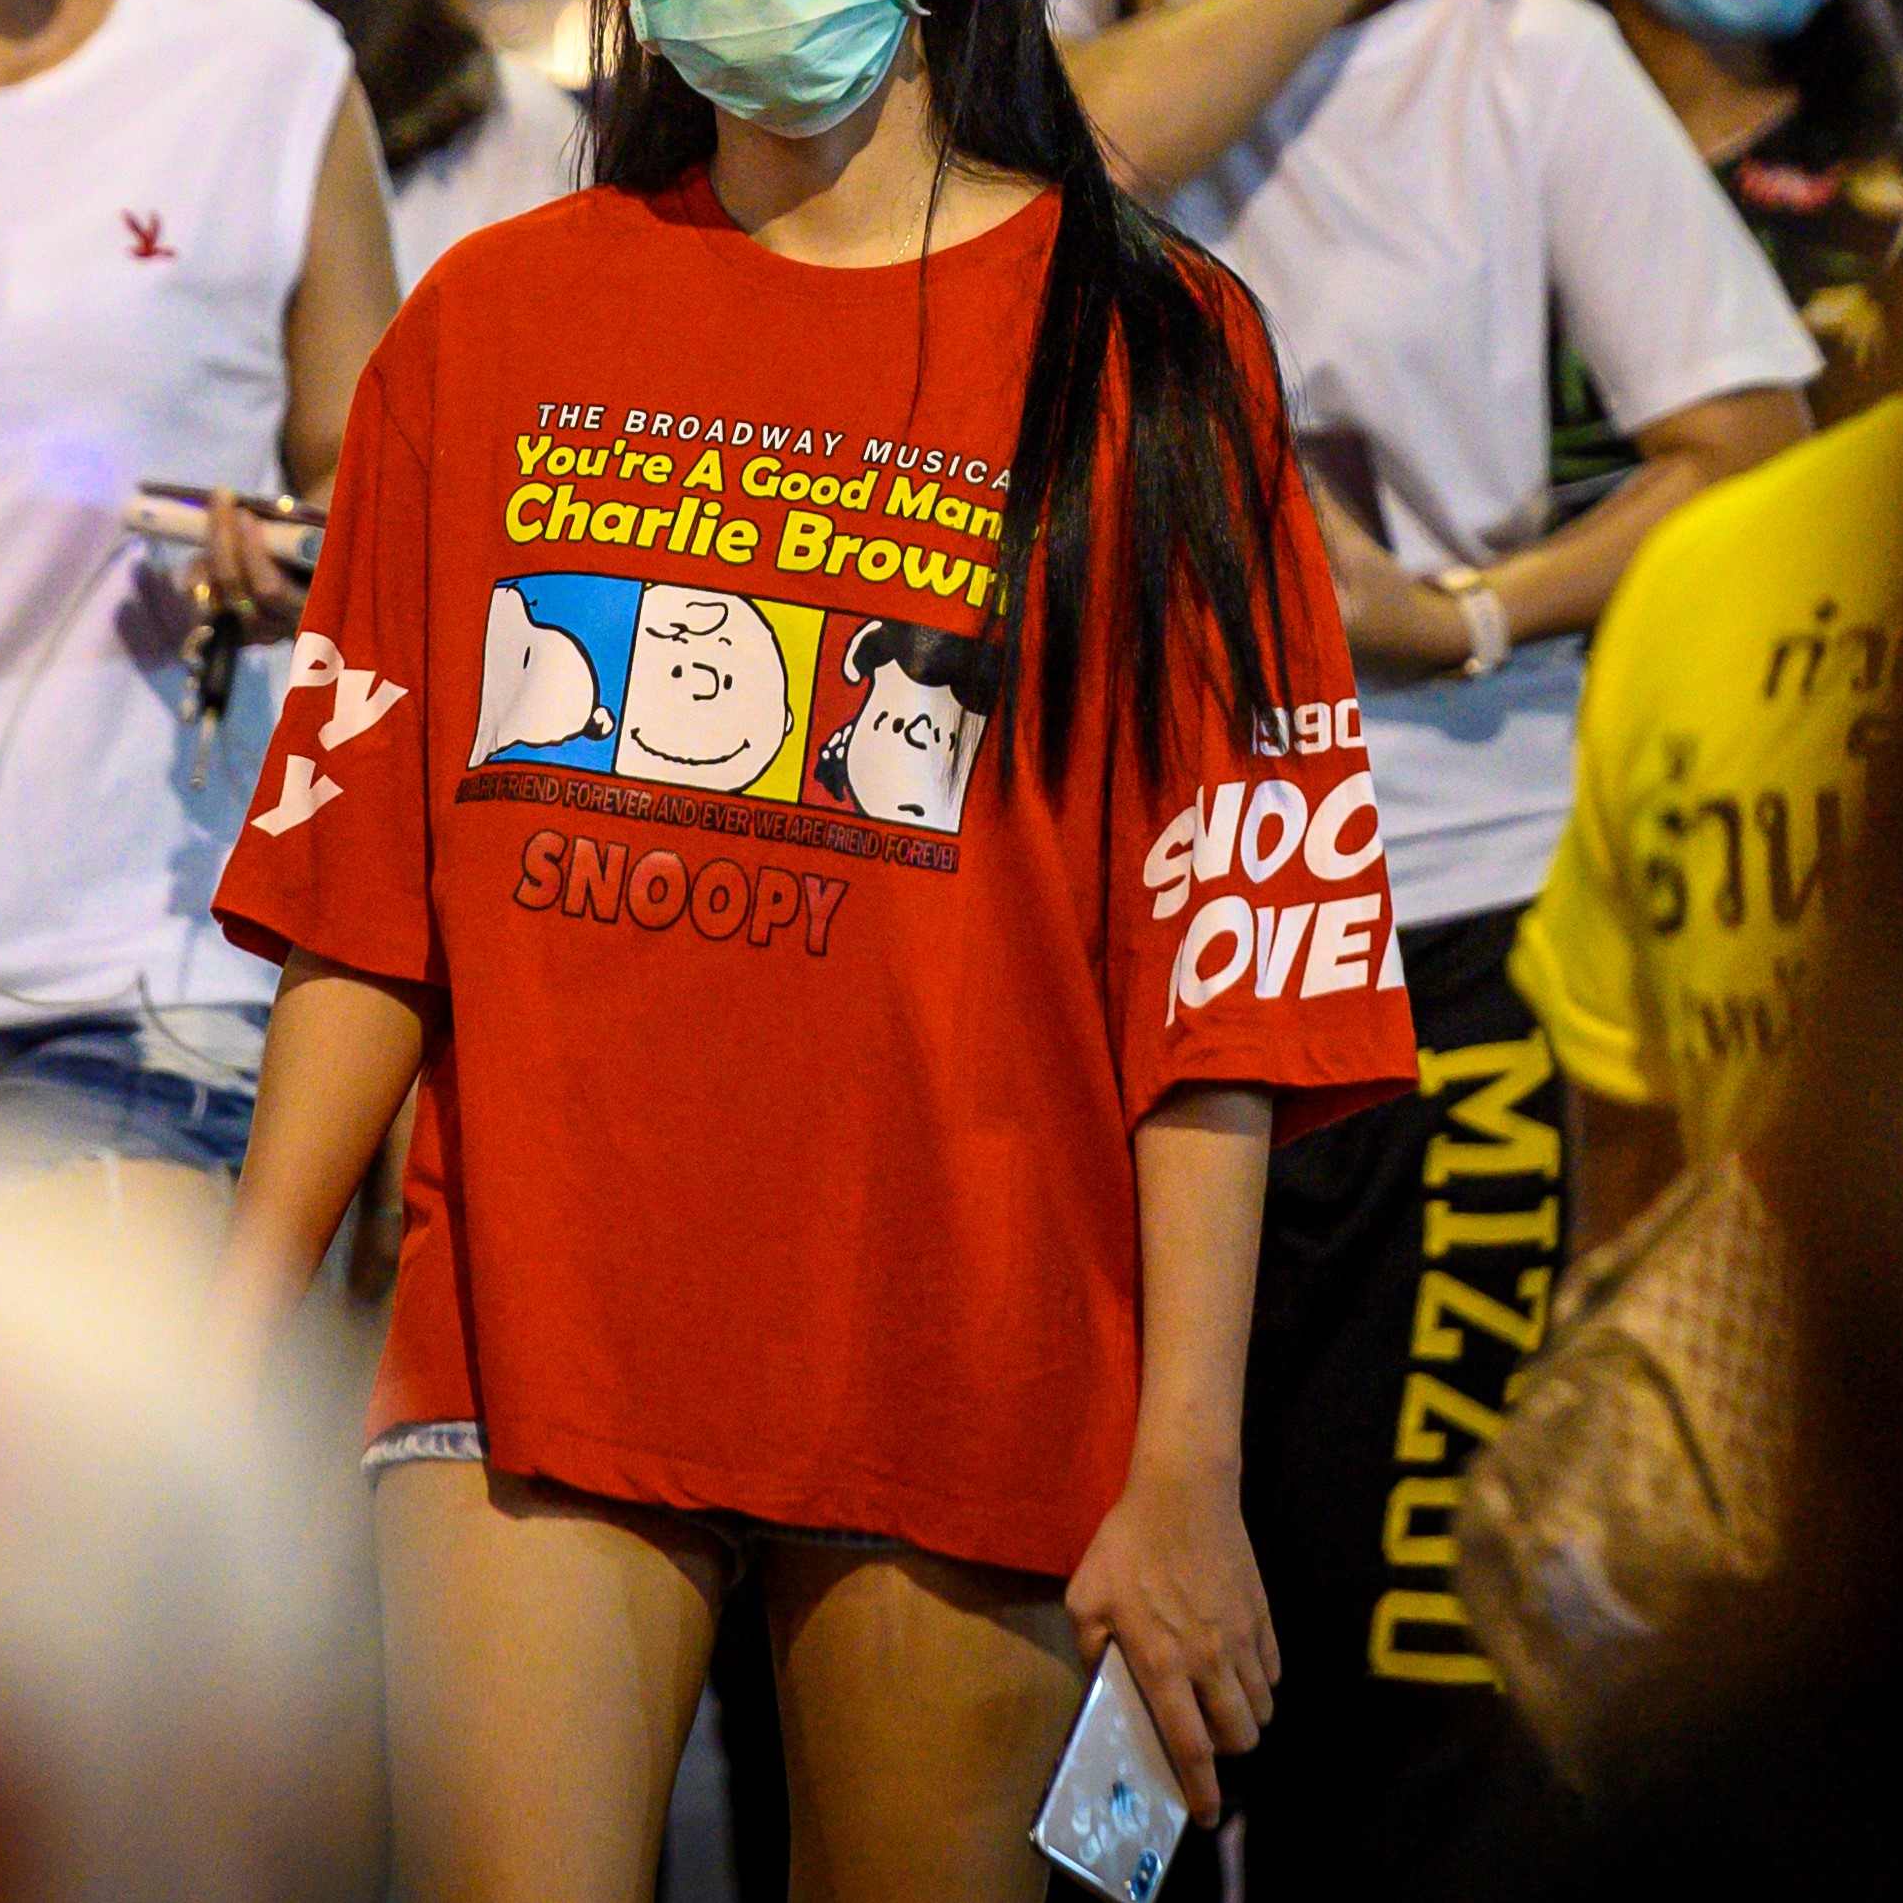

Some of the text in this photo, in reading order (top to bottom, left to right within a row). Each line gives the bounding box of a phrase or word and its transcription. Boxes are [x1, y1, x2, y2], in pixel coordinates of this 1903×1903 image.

[538, 403, 604, 429] THE
[624, 410, 844, 458] BROADWAY
[515, 434, 674, 484] You're
[683, 448, 724, 492] A
[741, 456, 881, 510] Good
[503, 482, 761, 564] Charlie
[1250, 698, 1367, 757] 990
[562, 777, 654, 821] FOREVER
[654, 792, 698, 828] AND
[699, 802, 749, 836] EVER
[754, 810, 786, 840] WE
[786, 815, 825, 847] ARE
[825, 820, 882, 860] FRIEND
[513, 828, 849, 957] SNOOPY
[1165, 892, 1406, 1028] OVE
